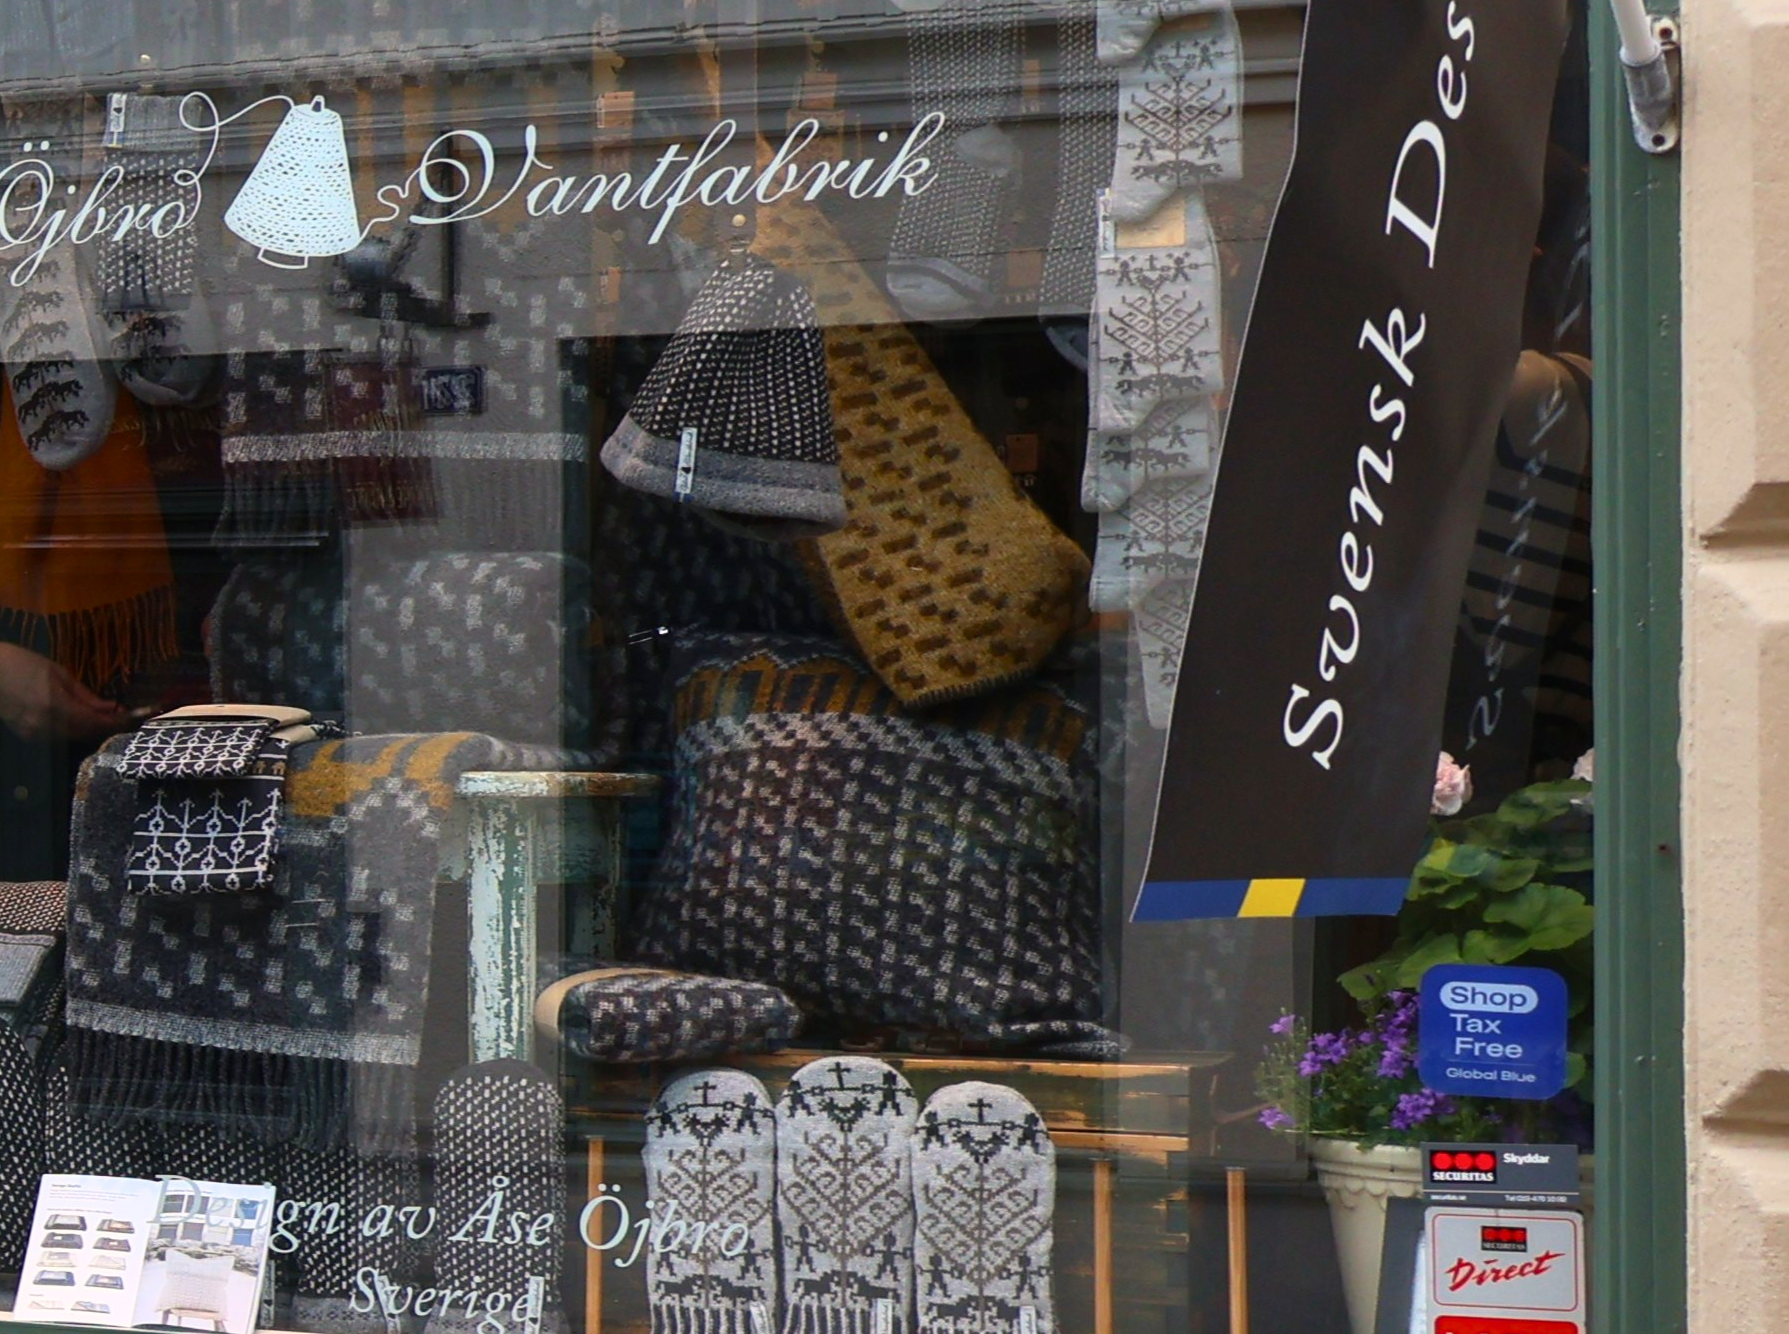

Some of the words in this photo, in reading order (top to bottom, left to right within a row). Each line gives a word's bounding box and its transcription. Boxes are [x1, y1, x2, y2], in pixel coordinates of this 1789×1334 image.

[410, 110, 945, 243] Vantfabrik
[1284, 309, 1427, 769] Svensk
[1450, 986, 1527, 1011] Shop
[1449, 1013, 1501, 1034] Tax
[1455, 1037, 1523, 1058] Free
[1446, 1067, 1497, 1080] Global
[1500, 1070, 1536, 1083] Blue
[1433, 1172, 1494, 1182] SECURITAS
[146, 1175, 342, 1254] Design
[359, 1200, 436, 1241] av
[449, 1176, 554, 1246] Åse
[579, 1184, 749, 1267] Öjbro
[1445, 1251, 1566, 1292] Direct
